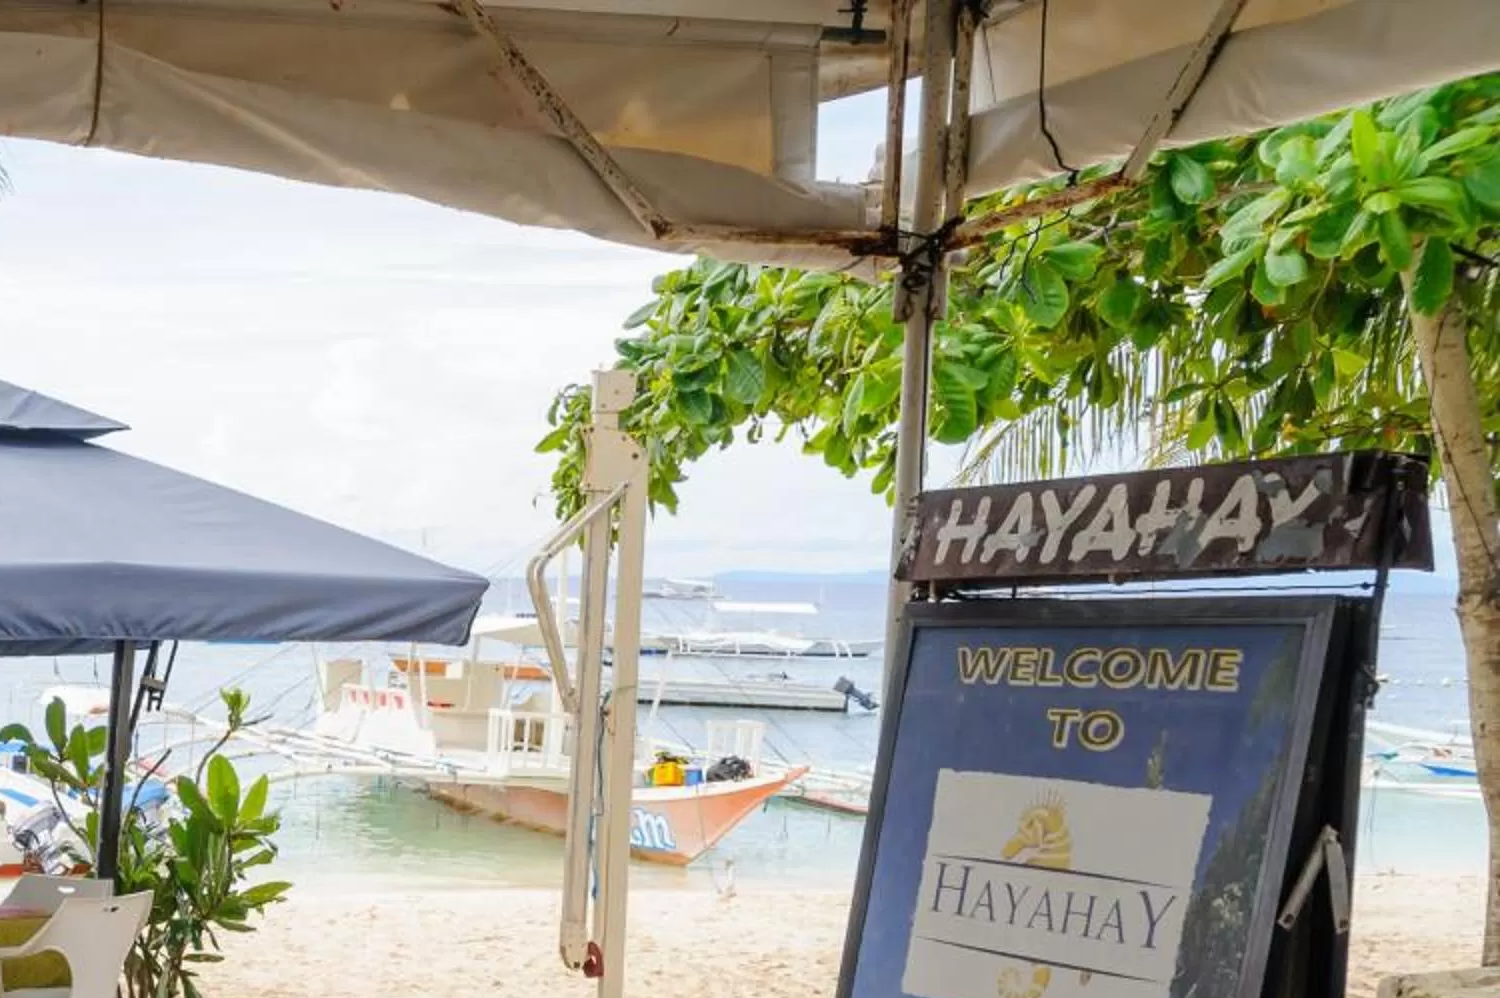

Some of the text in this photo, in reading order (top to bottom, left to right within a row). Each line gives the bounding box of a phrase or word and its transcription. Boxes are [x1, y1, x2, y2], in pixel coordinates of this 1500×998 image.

[933, 471, 1333, 567] HAYAHAY
[957, 646, 1244, 693] WELCOME
[1046, 707, 1126, 752] TO
[930, 861, 1178, 950] HAYAHAY
